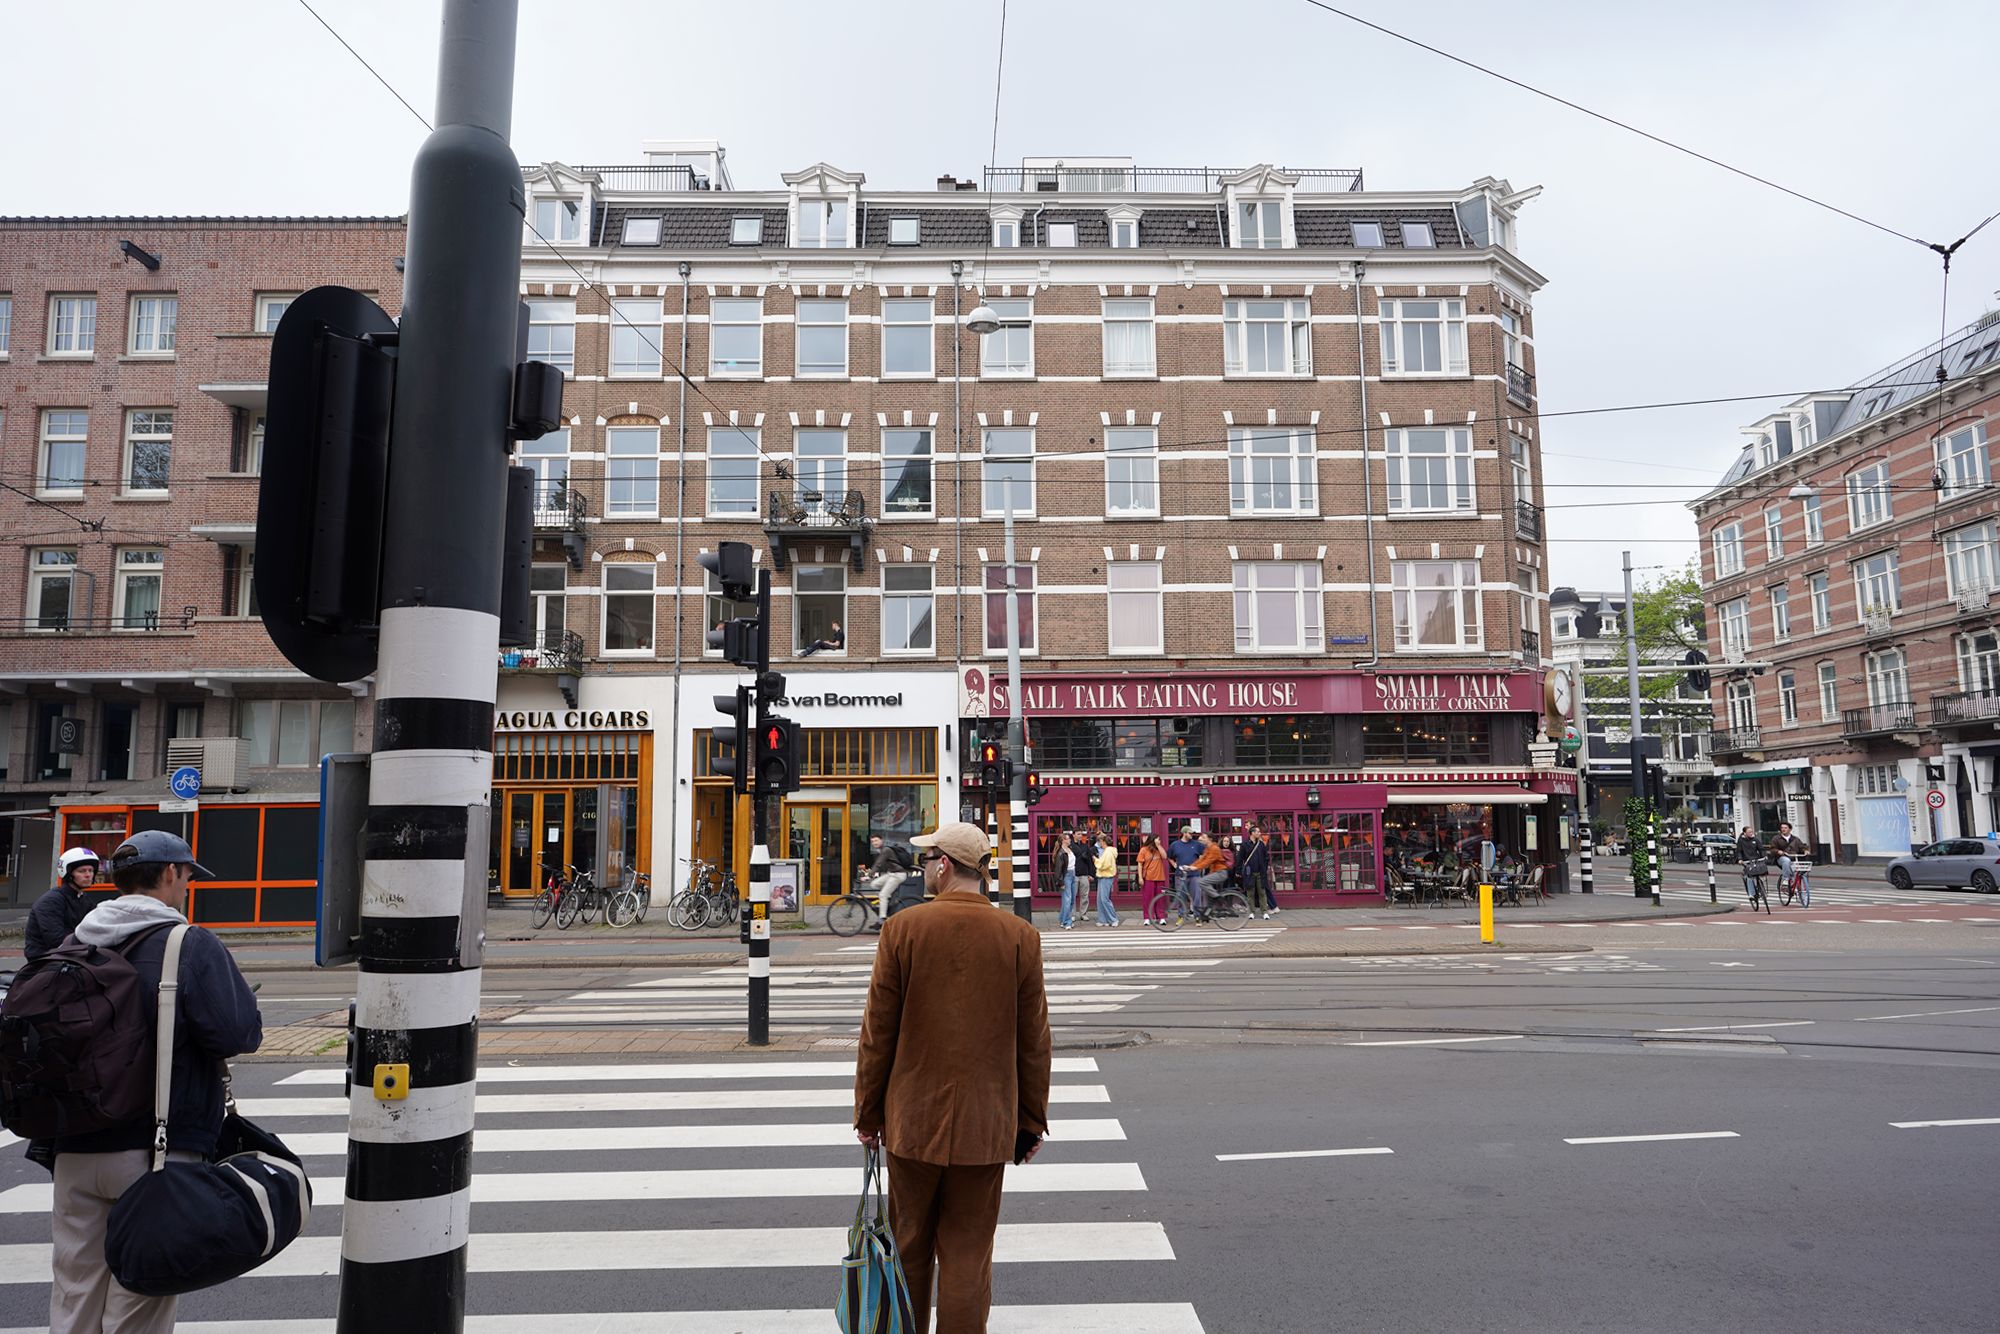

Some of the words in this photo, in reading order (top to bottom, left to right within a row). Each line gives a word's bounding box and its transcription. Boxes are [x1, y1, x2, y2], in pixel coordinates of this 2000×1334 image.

[1375, 675, 1446, 698] SMALL
[1454, 674, 1512, 698] TALK
[791, 696, 822, 707] van
[824, 692, 903, 707] Bommel
[1071, 684, 1128, 710] TALK
[1136, 683, 1217, 709] EATING
[1227, 682, 1298, 708] HOUSE
[1383, 698, 1440, 711] COFFEE
[1448, 697, 1510, 711] CORNER
[564, 710, 649, 728] CIGARS
[1930, 795, 1942, 804] 30
